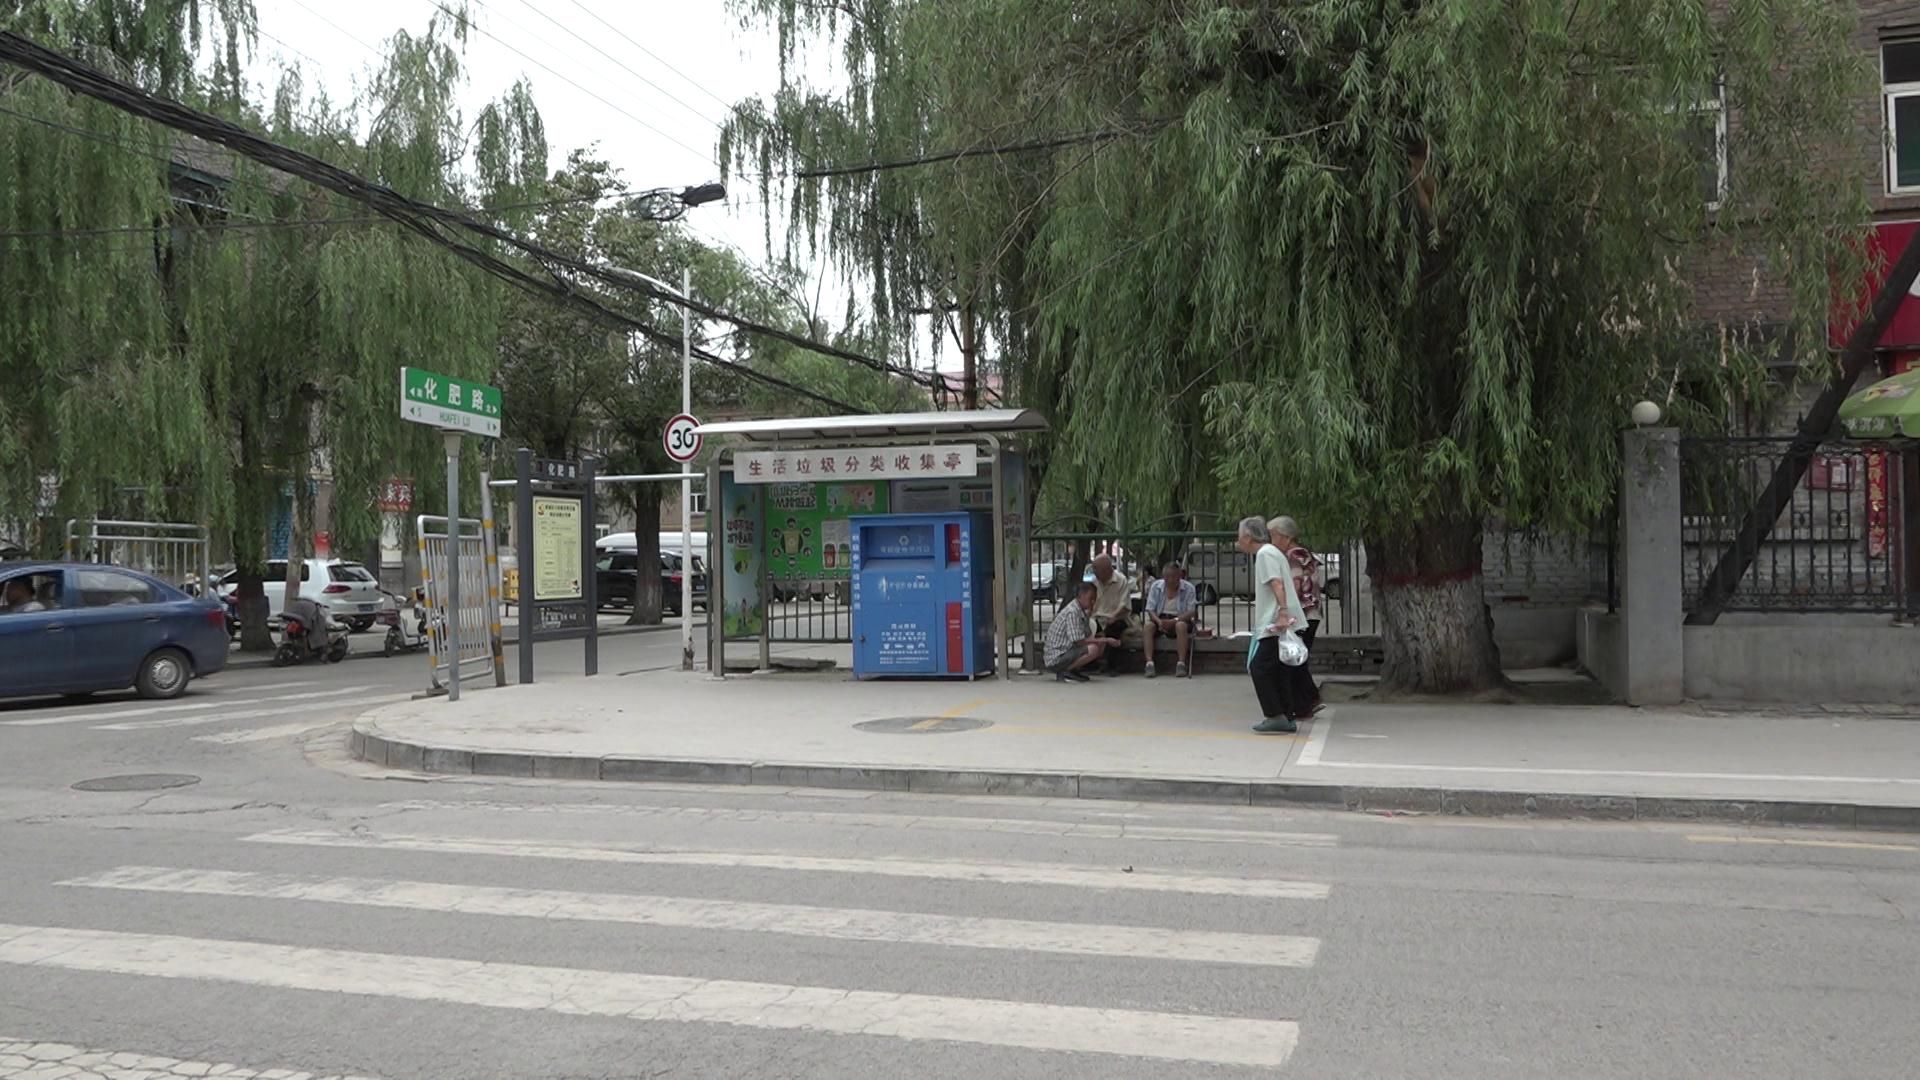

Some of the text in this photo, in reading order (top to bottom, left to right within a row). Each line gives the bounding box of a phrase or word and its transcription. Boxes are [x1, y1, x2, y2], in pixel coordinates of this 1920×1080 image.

[424, 377, 484, 411] 化肥路
[439, 411, 471, 427] HUAFEI LU
[671, 427, 695, 449] 30
[749, 452, 962, 476] 生活垃圾分类收集亭
